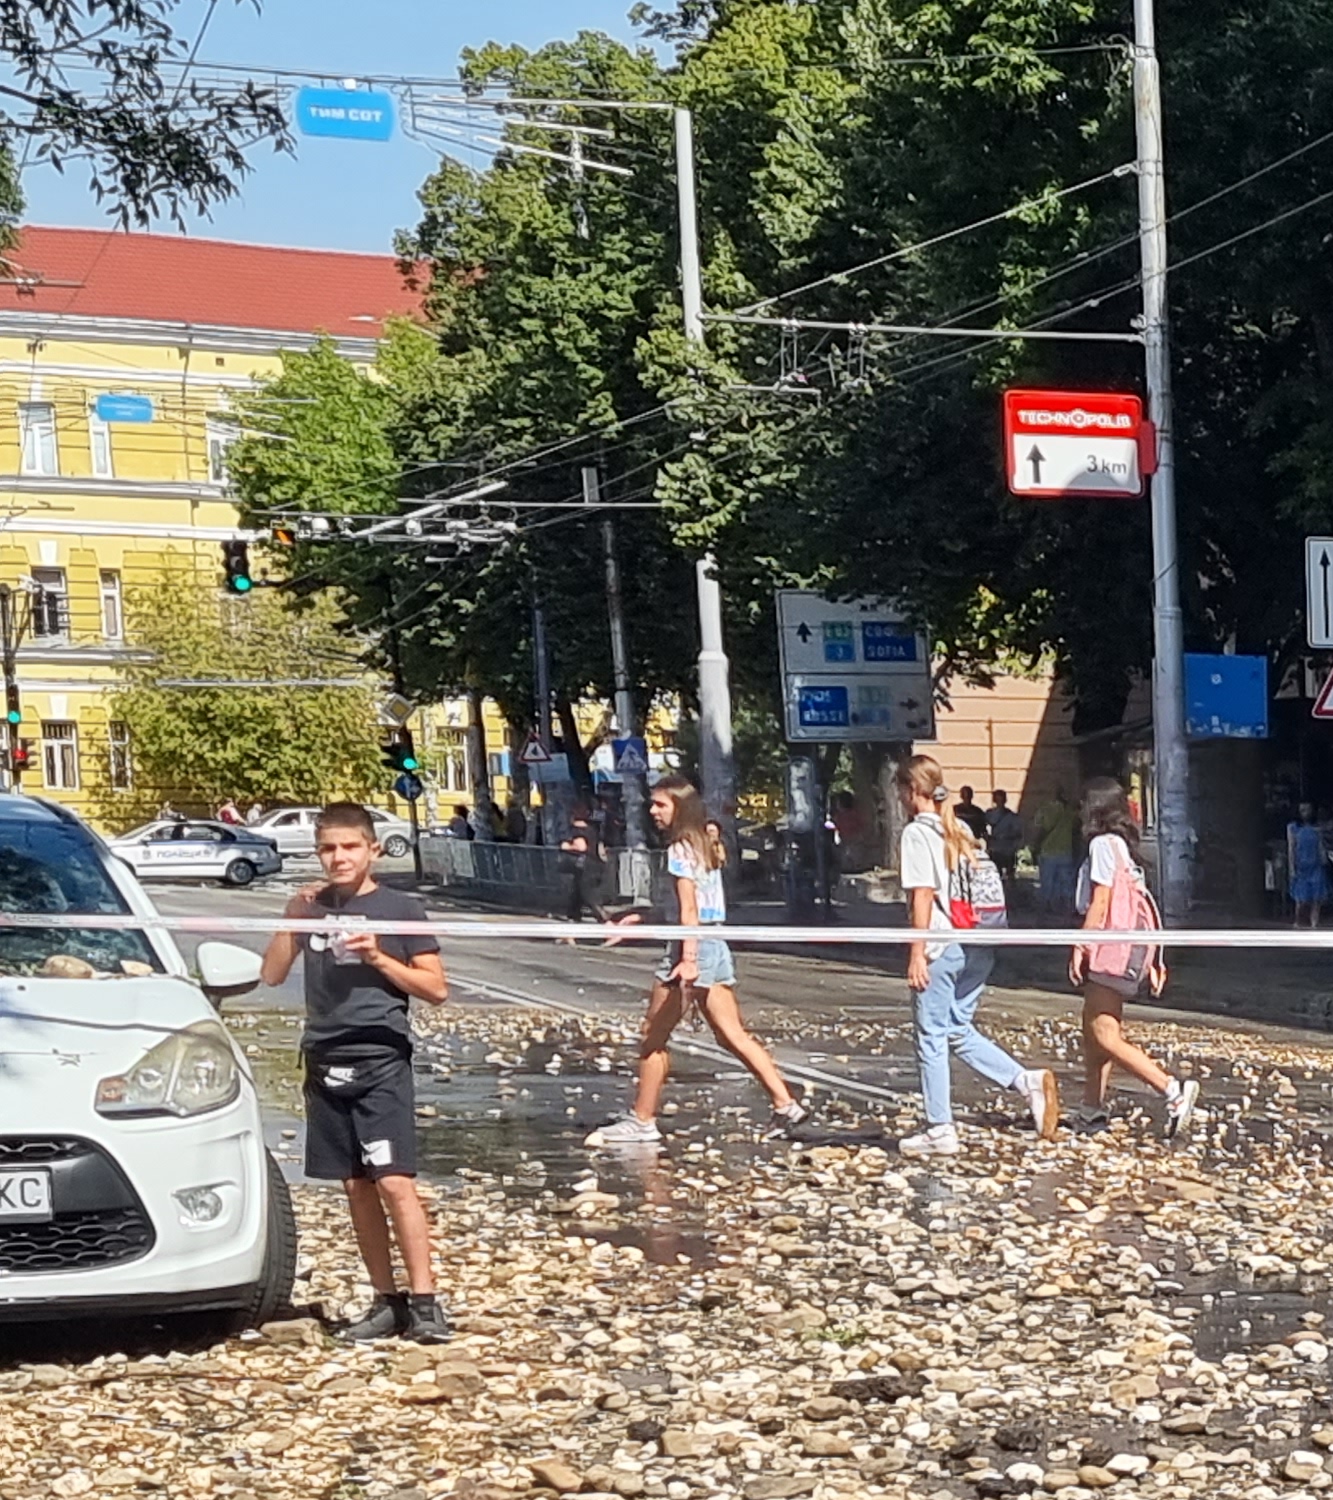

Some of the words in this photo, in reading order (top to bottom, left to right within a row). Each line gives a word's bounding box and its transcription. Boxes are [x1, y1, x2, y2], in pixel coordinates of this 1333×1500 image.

[1017, 409, 1131, 428] TECHNOPOLIS
[1087, 455, 1098, 473] 3
[1101, 459, 1127, 474] km
